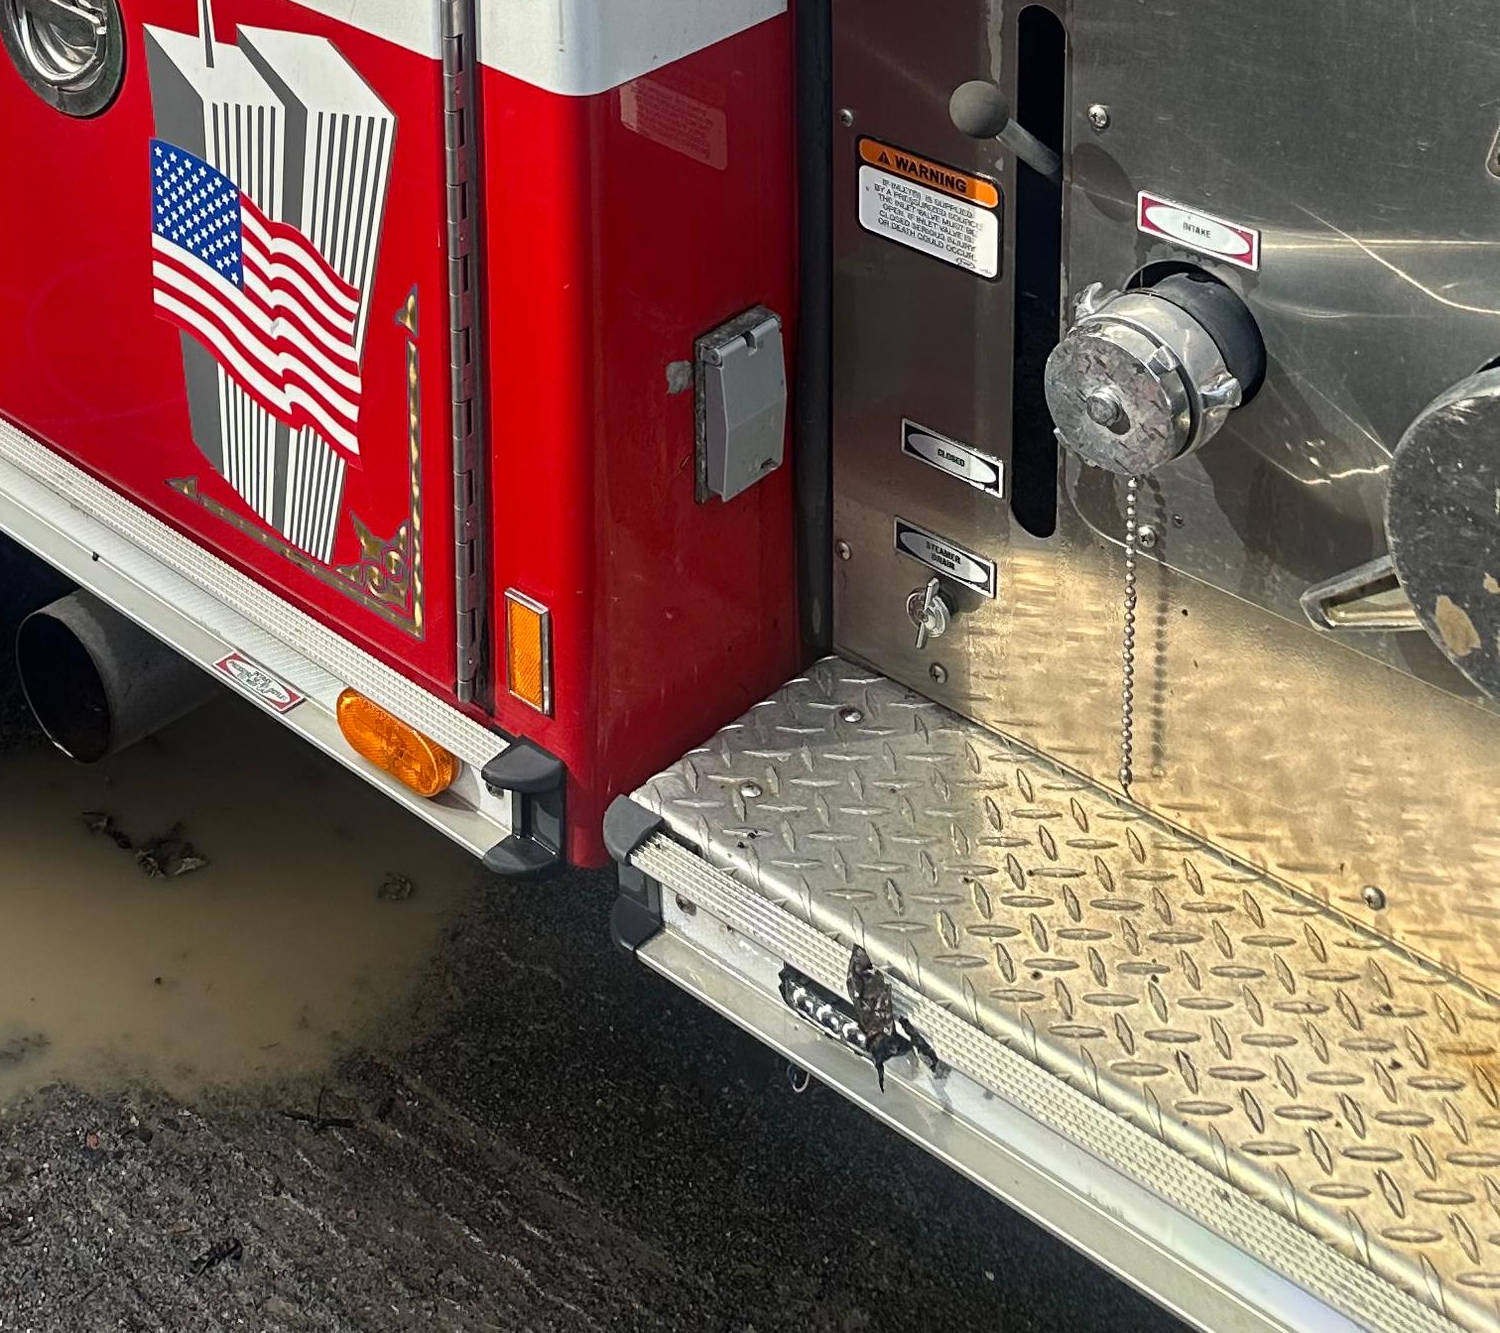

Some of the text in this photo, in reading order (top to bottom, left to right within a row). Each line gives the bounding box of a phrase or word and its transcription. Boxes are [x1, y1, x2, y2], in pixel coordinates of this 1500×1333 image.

[894, 155, 967, 194] WARNING
[934, 197, 973, 219] SUPPLIED
[891, 222, 916, 238] DEATH
[917, 233, 944, 250] COULD
[1182, 221, 1212, 239] INTAKE
[936, 447, 966, 468] CLOSED
